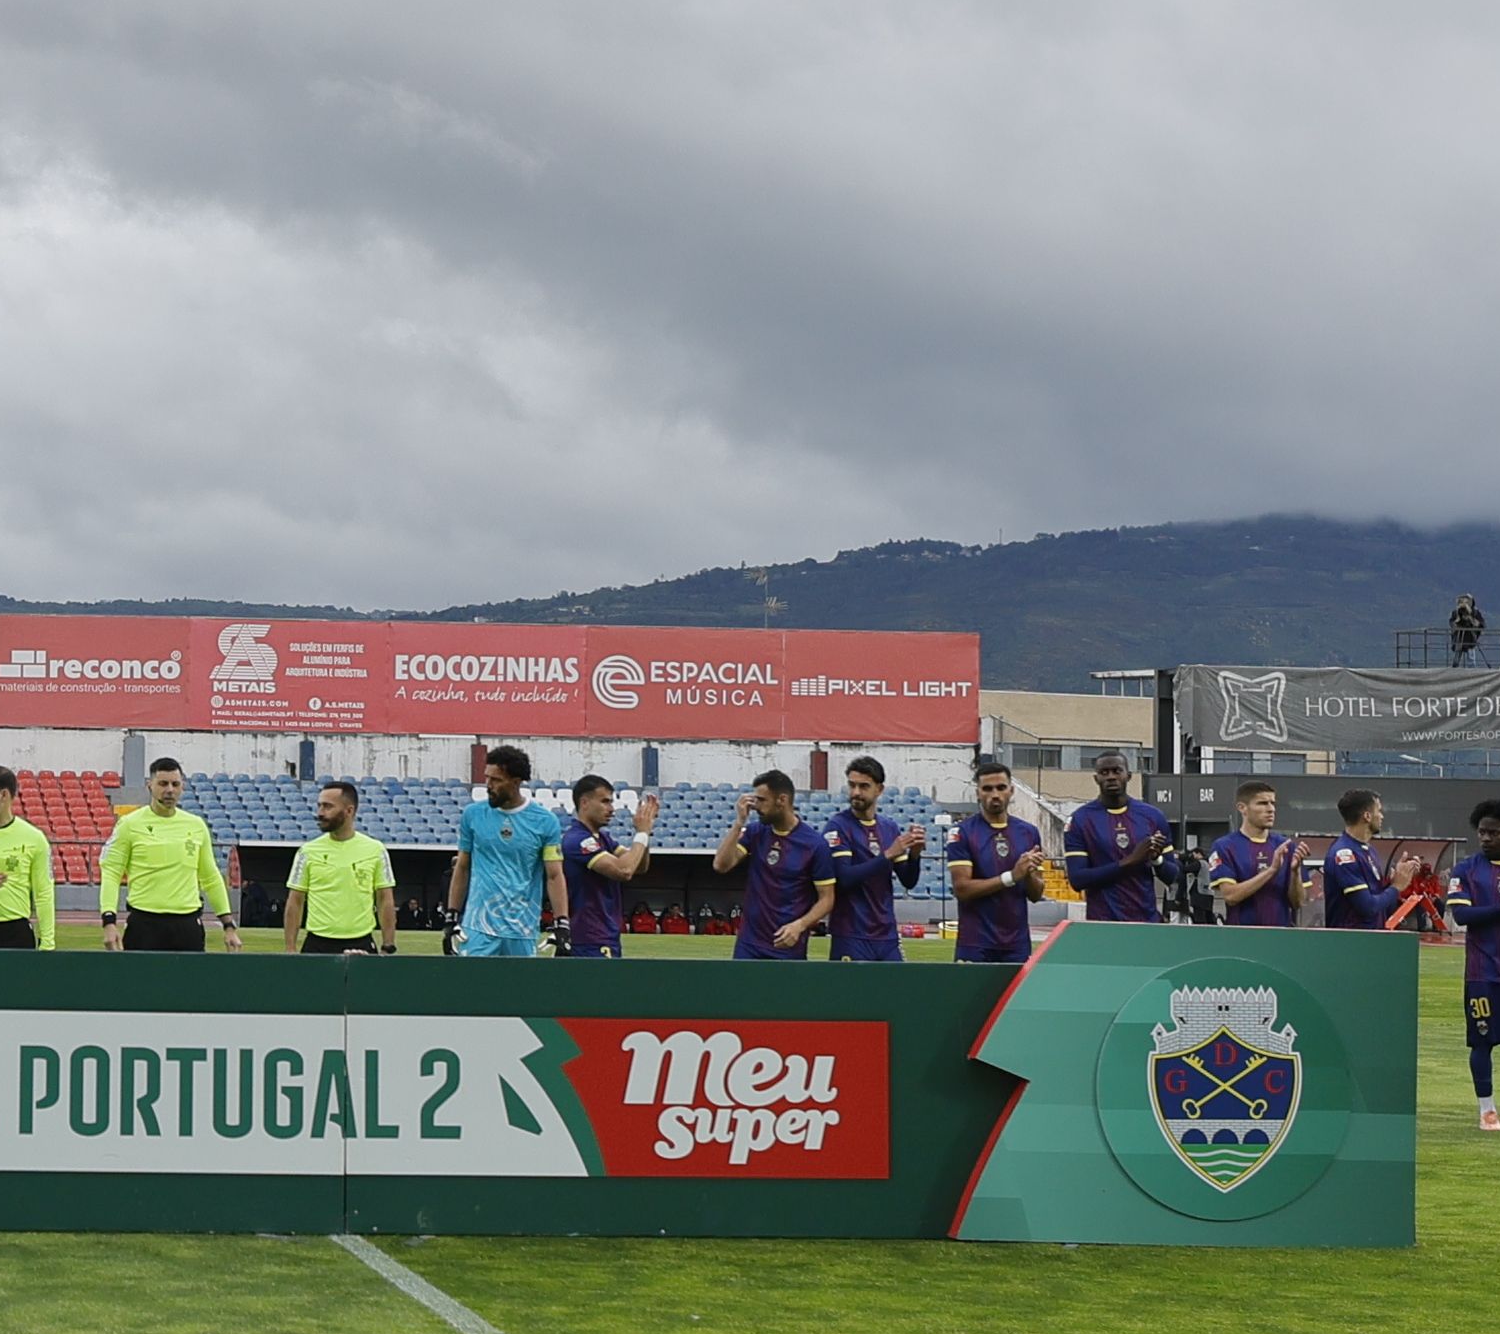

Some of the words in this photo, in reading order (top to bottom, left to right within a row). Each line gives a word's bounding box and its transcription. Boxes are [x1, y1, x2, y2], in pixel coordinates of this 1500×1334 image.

[289, 642, 321, 654] SOLUÇÕES
[322, 643, 332, 653] EM
[356, 644, 364, 653] DE
[50, 659, 181, 679] reconco
[303, 655, 333, 665] ALUMÍNIO
[334, 657, 351, 665] PARA
[395, 654, 579, 684] ECOCOZ!NHAS
[334, 668, 368, 678] INDÚSTRIA
[650, 661, 778, 685] ESPACIAL
[45, 682, 58, 692] de
[60, 682, 116, 694] construção
[124, 683, 181, 695] transportes
[213, 681, 276, 693] METAIS
[394, 686, 406, 699] A
[412, 684, 468, 703] cozinha,
[474, 687, 506, 702] tudo
[511, 686, 568, 703] incluído
[666, 685, 763, 707] MÚSICA
[828, 680, 897, 696] PIXEL
[903, 681, 972, 698] LIGHT
[225, 699, 289, 707] ASMETAIS.COM
[1305, 696, 1382, 718] HOTEL
[1392, 696, 1468, 718] FORTE
[1156, 790, 1166, 802] WC
[1200, 788, 1214, 802] BAR
[1470, 997, 1491, 1019] 30
[1214, 1042, 1237, 1067] D
[19, 1043, 400, 1140] PORTUGAL
[419, 1047, 461, 1140] 2
[1164, 1069, 1188, 1095] G
[1264, 1069, 1285, 1094] C
[654, 1101, 841, 1166] super
